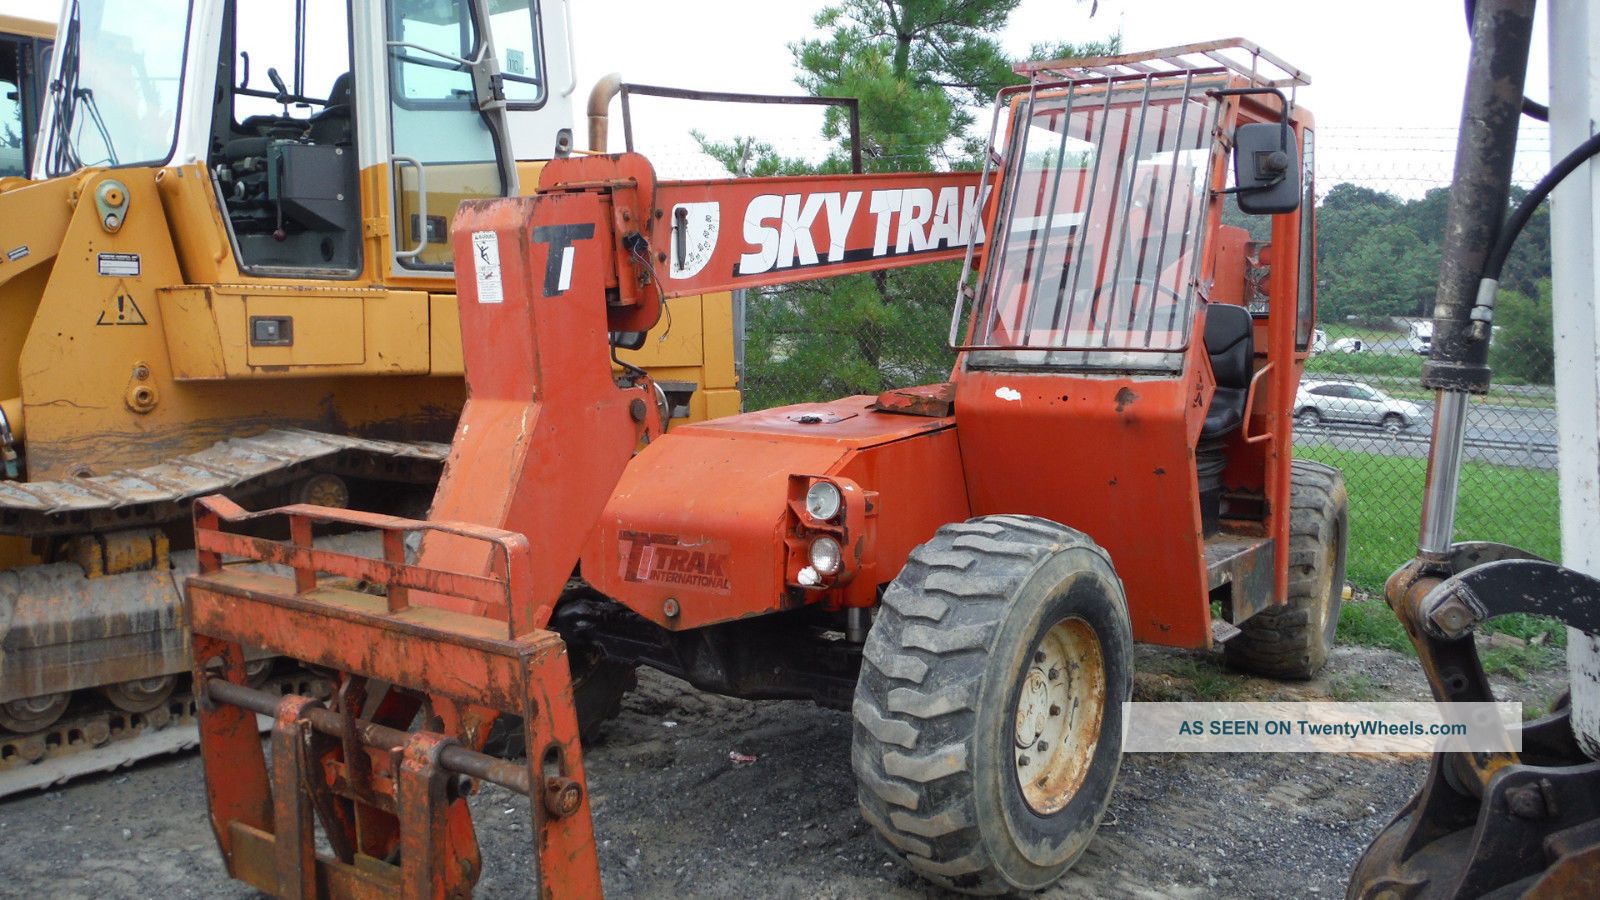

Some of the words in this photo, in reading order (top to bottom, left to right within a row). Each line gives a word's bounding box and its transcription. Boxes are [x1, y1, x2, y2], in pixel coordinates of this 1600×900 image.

[739, 191, 863, 274] SKY
[868, 184, 993, 257] TRAK
[655, 547, 729, 577] TRAK
[650, 569, 729, 590] INTERNATIONAL
